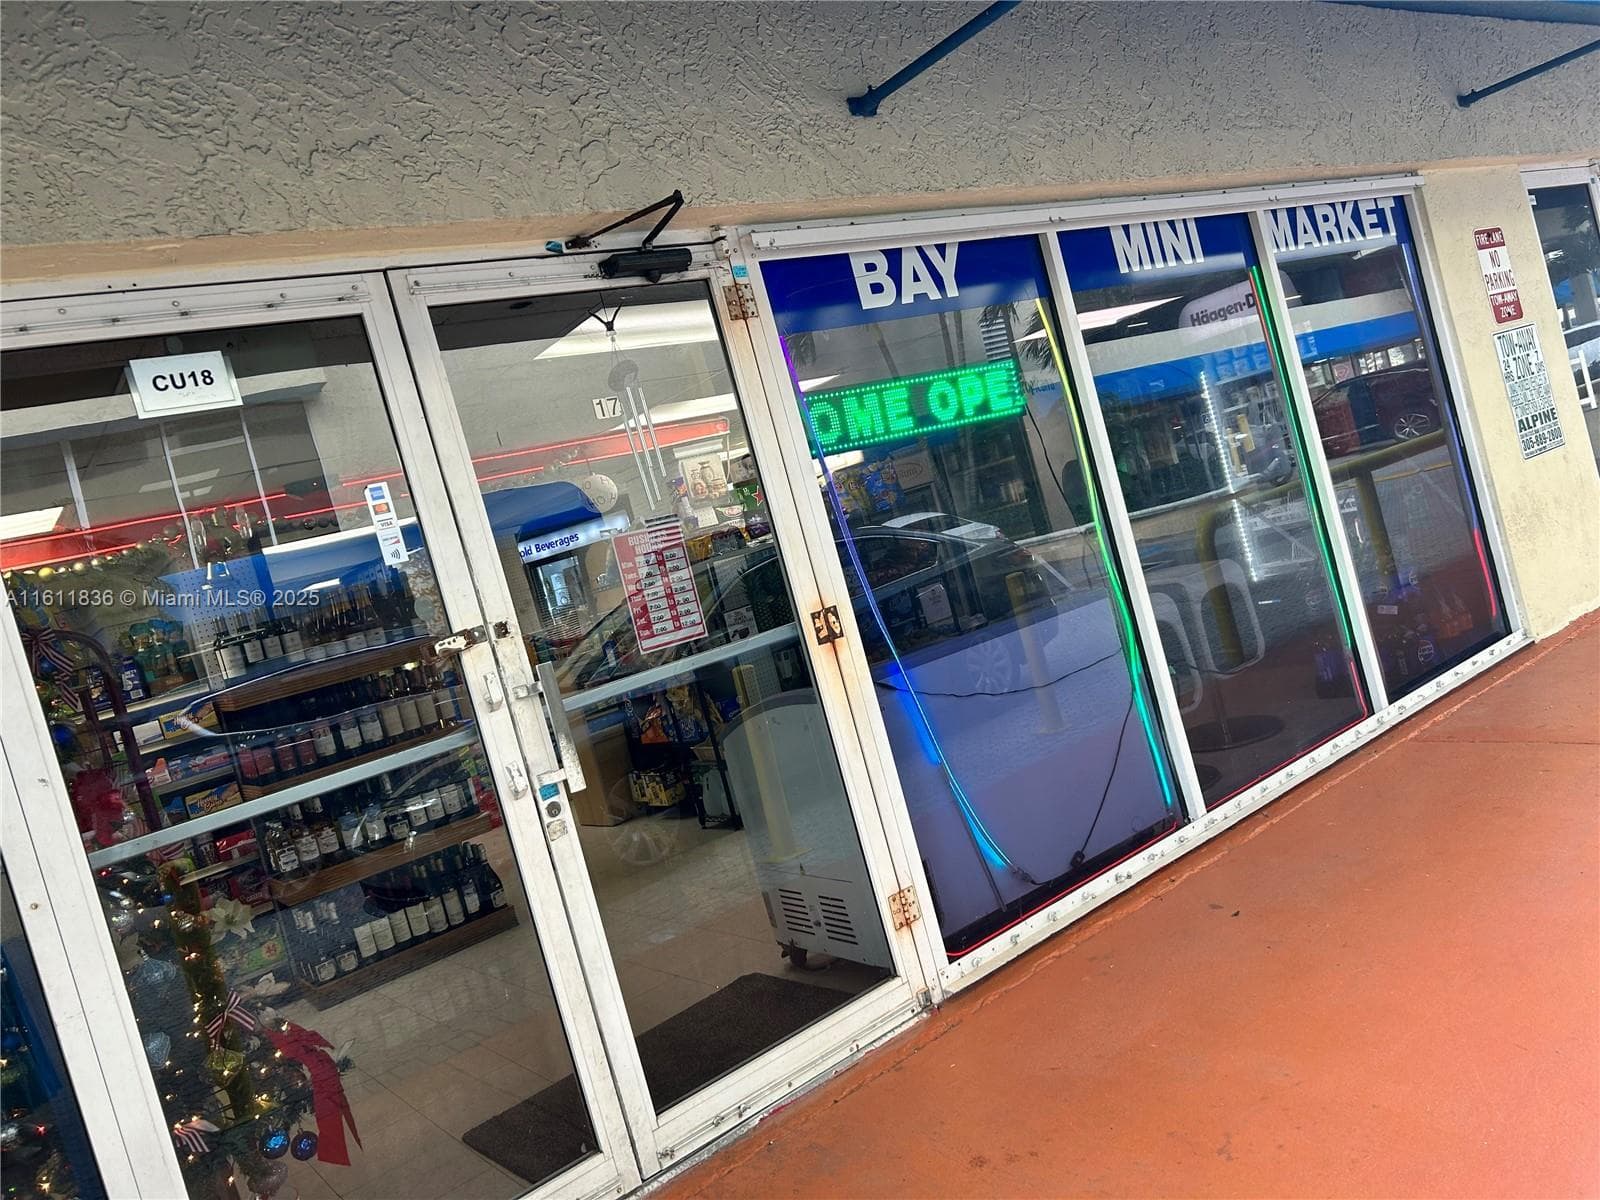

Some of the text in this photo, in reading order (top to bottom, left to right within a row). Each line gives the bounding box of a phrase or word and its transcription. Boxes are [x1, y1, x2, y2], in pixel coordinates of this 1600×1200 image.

[1475, 231, 1504, 246] FIRE LANE
[850, 197, 1397, 310] BAY MINI MARKET
[1489, 250, 1501, 269] NO
[1484, 269, 1516, 291] PARKING
[1490, 291, 1518, 306] TOW-AWAY
[1499, 305, 1518, 318] ZONE
[1497, 327, 1537, 359] TOW-AWAY
[1503, 350, 1540, 380] 24 ZONE 7
[151, 369, 216, 394] CU18
[1504, 370, 1515, 384] HRS
[595, 397, 618, 418] 17
[809, 385, 915, 446] OME
[1517, 407, 1558, 434] ALPINE
[380, 520, 393, 528] VISA
[535, 532, 579, 553] Beverages
[636, 541, 662, 555] HOU
